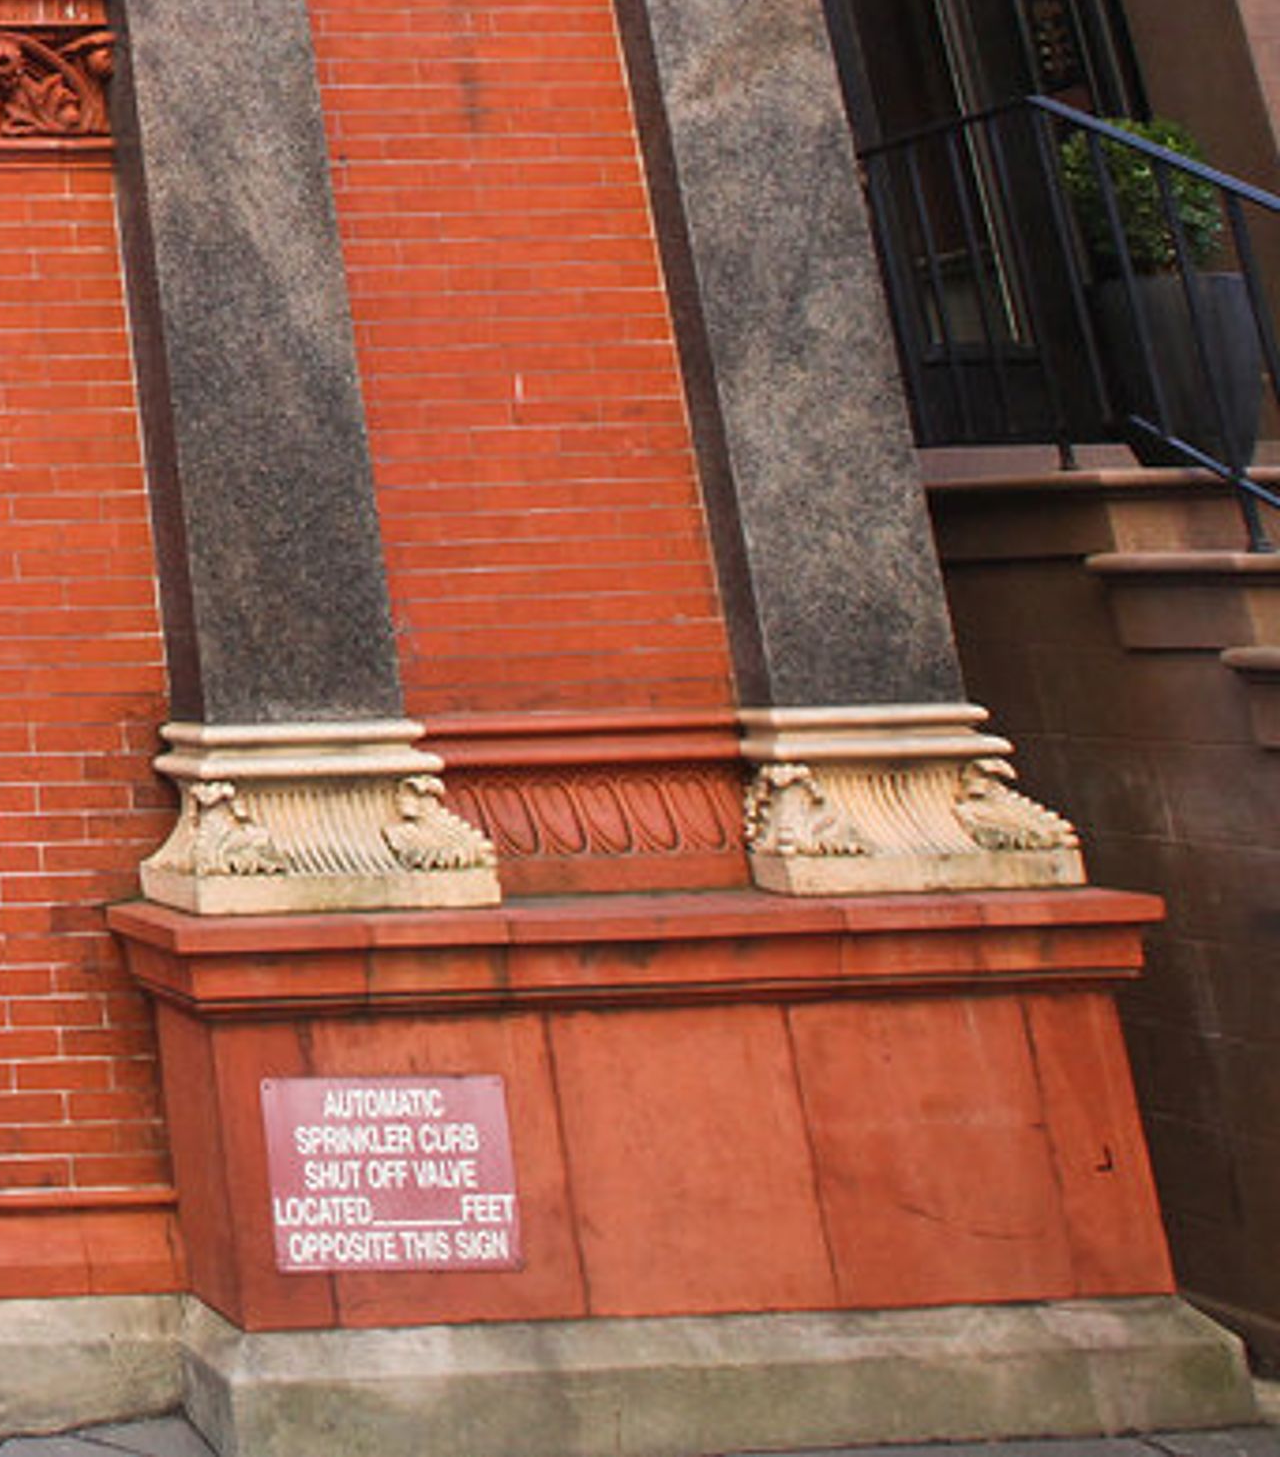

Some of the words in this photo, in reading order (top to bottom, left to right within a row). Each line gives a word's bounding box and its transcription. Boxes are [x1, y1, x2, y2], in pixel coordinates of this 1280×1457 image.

[323, 1088, 445, 1117] AUTOMATIC
[294, 1123, 415, 1155] SPRINKLER
[419, 1122, 480, 1152] CURB
[304, 1159, 362, 1190] SHUT
[366, 1159, 408, 1188] OFF
[412, 1159, 478, 1188] VALVE
[273, 1195, 373, 1226] LOCATED
[461, 1193, 515, 1222] FEET
[289, 1230, 397, 1262] OPPOSITE
[399, 1229, 451, 1260] THIS
[454, 1229, 511, 1260] SIGN
